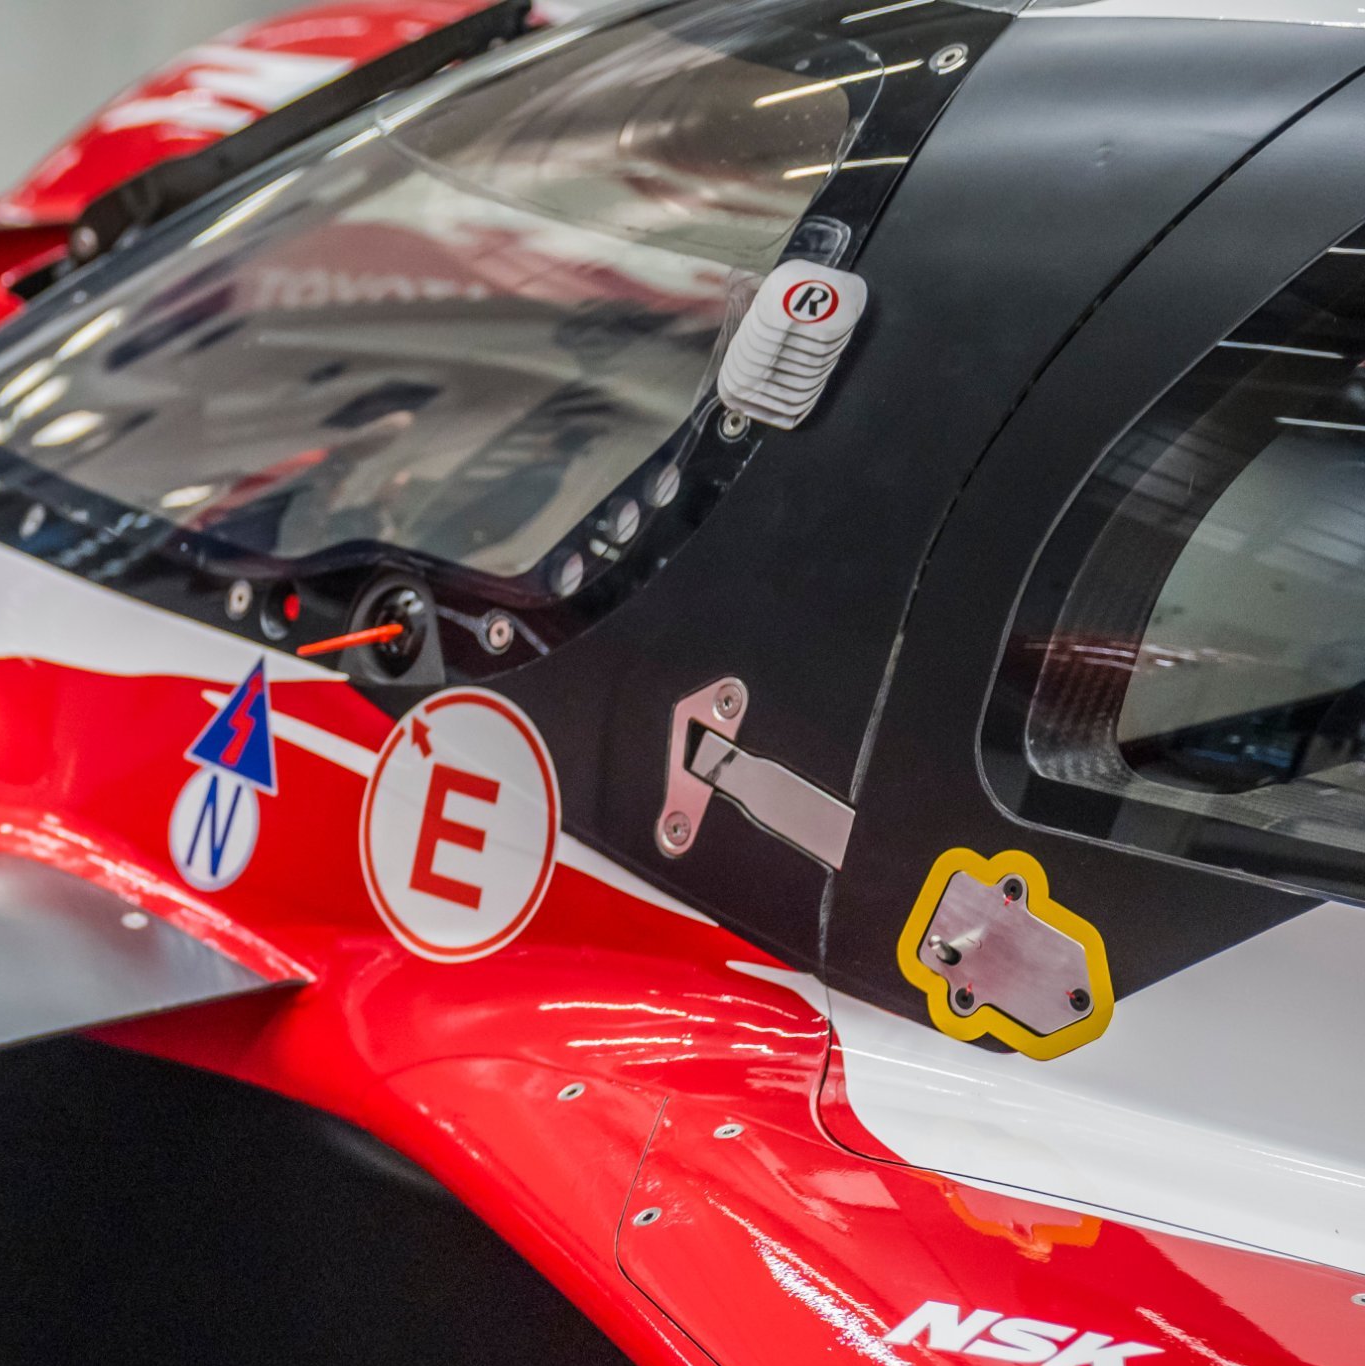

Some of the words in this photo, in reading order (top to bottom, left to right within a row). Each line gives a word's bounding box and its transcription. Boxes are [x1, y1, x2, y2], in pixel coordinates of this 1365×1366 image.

[792, 284, 829, 318] R
[185, 772, 244, 879] N
[409, 763, 501, 911] E
